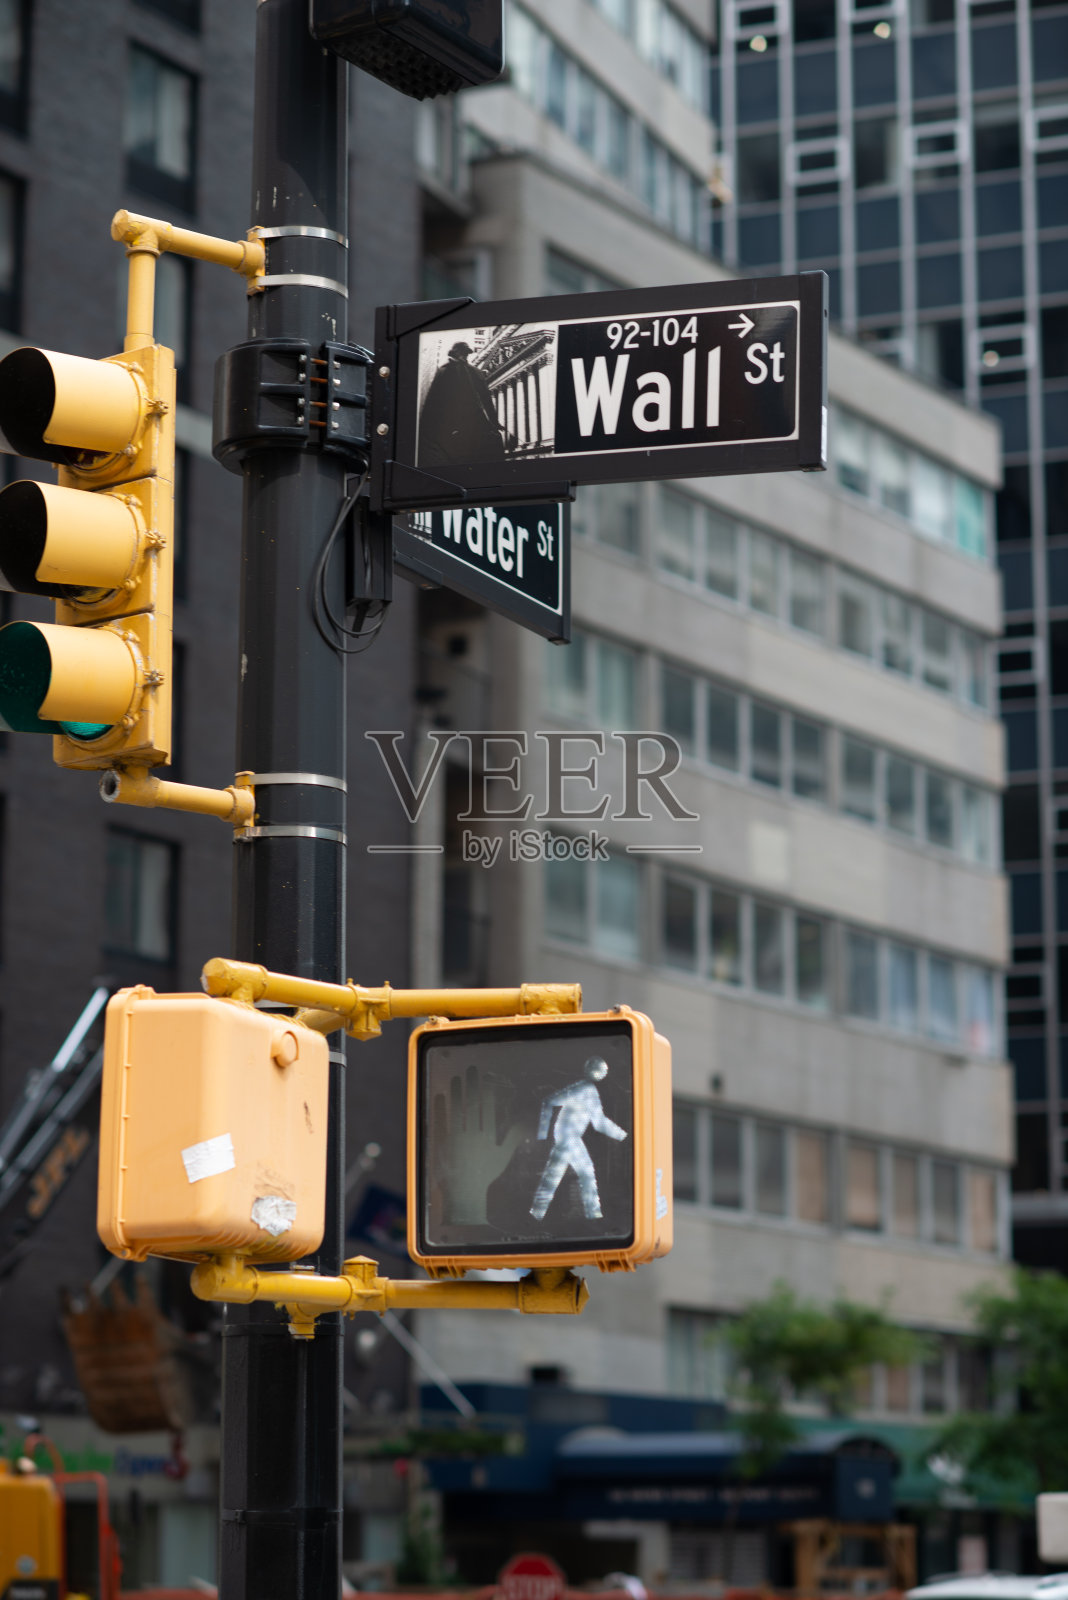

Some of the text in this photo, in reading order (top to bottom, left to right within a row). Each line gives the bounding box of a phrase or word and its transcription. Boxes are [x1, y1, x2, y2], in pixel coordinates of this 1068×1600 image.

[606, 316, 699, 349] 92-104
[571, 342, 786, 437] Wall St
[442, 506, 555, 579] Water St
